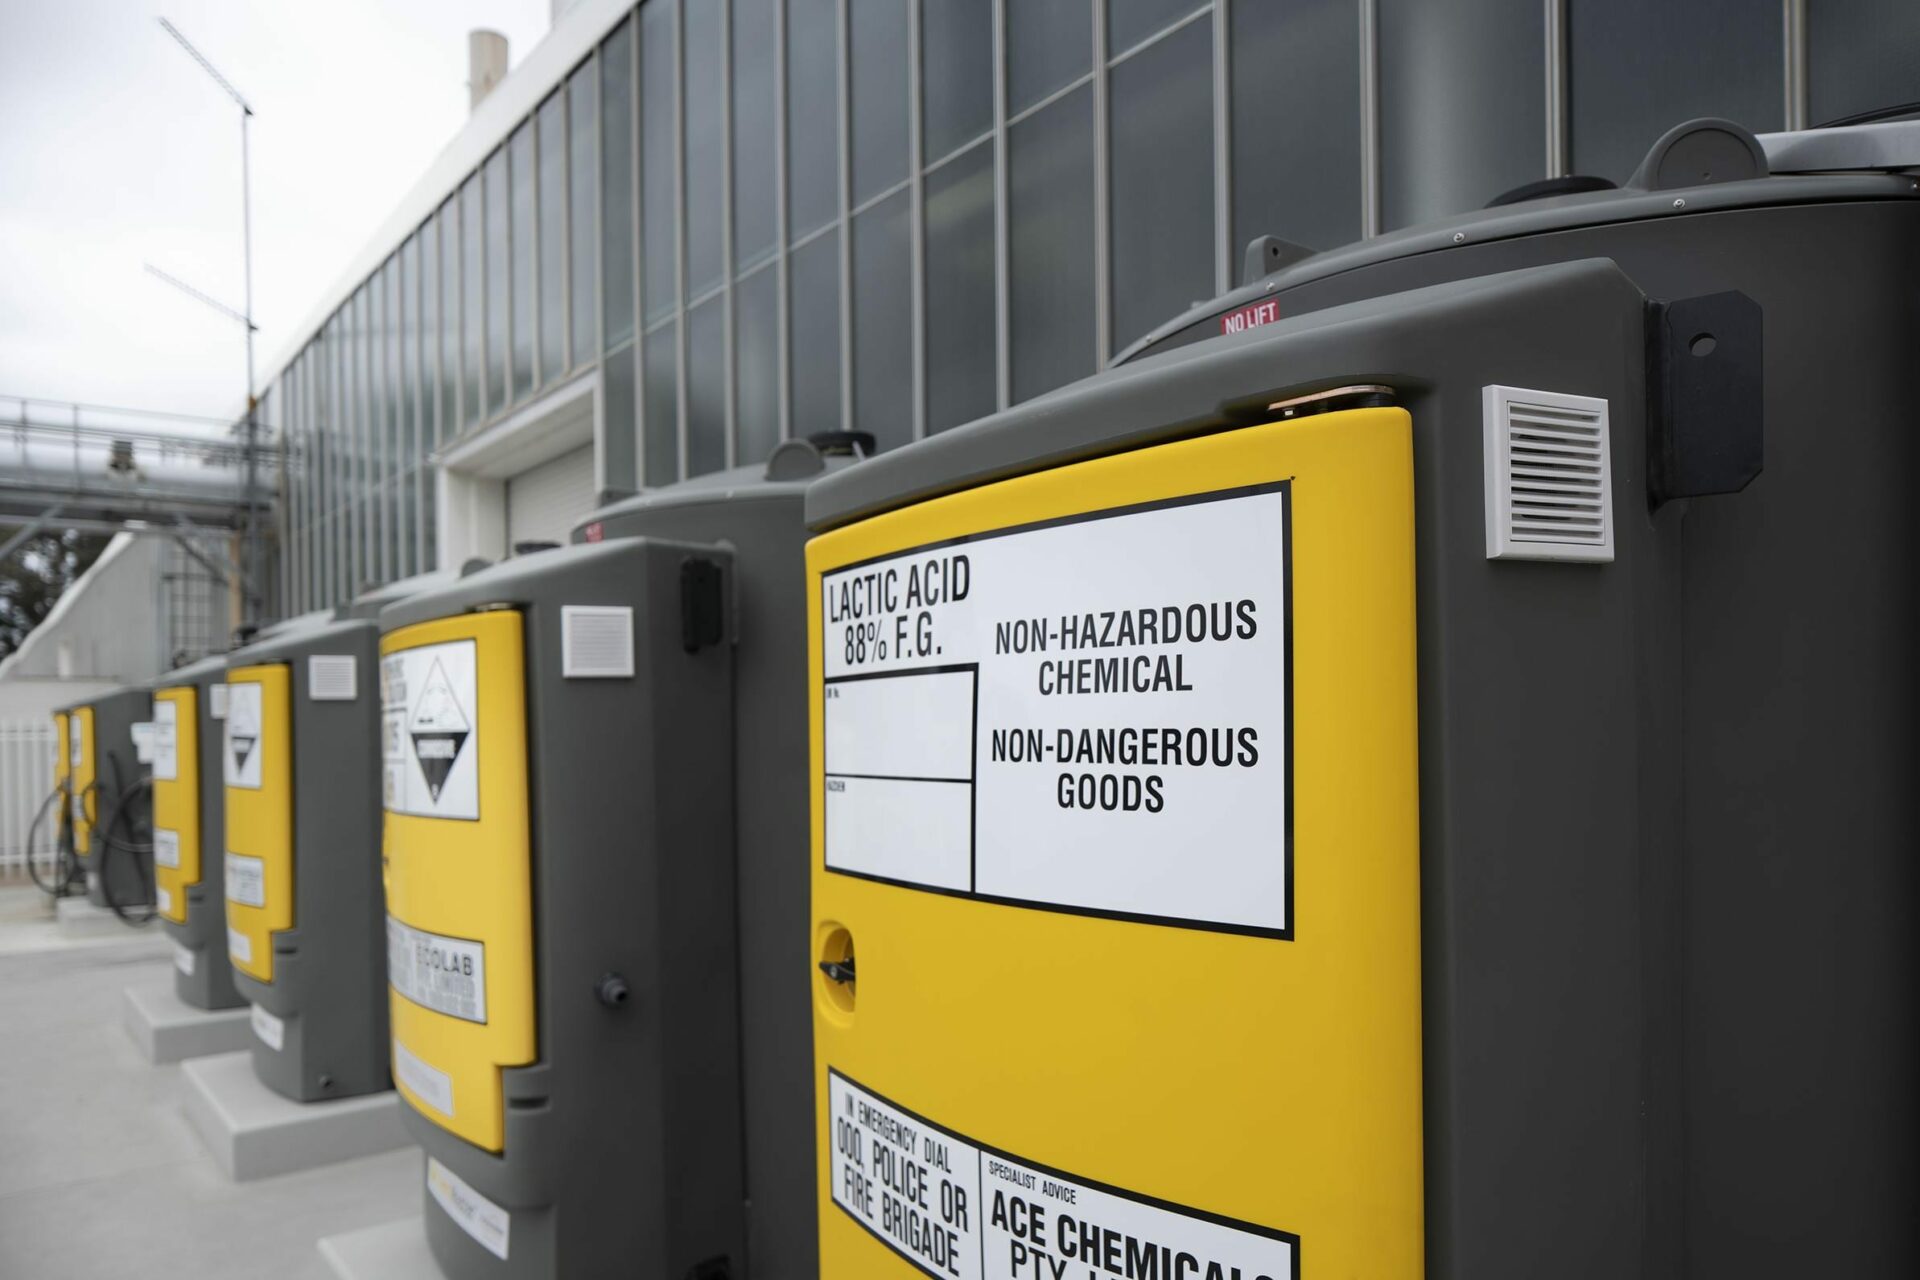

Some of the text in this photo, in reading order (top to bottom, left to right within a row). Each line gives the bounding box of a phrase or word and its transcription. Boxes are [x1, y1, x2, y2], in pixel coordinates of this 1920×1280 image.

[1225, 302, 1276, 335] NO LIFT
[830, 554, 970, 624] LACTIC ACID
[845, 610, 942, 665] 88% F.G.
[995, 599, 1258, 655] NON-HAZARDOUS
[1038, 653, 1193, 696] CHEMICAL
[991, 727, 1260, 768] NON-DANGEROUS
[1057, 772, 1164, 813] GOODS
[416, 942, 474, 977] ECOLAB
[845, 1093, 952, 1174] IN EMERGENCY DIAL
[873, 1138, 929, 1211] POLICE
[941, 1178, 968, 1233] OR
[989, 1160, 1076, 1205] SPECIALIST ADVICE
[844, 1163, 960, 1277] FIRE BRIGADE
[992, 1189, 1276, 1280] ACE CHEMIC
[1010, 1238, 1068, 1280] PTY
